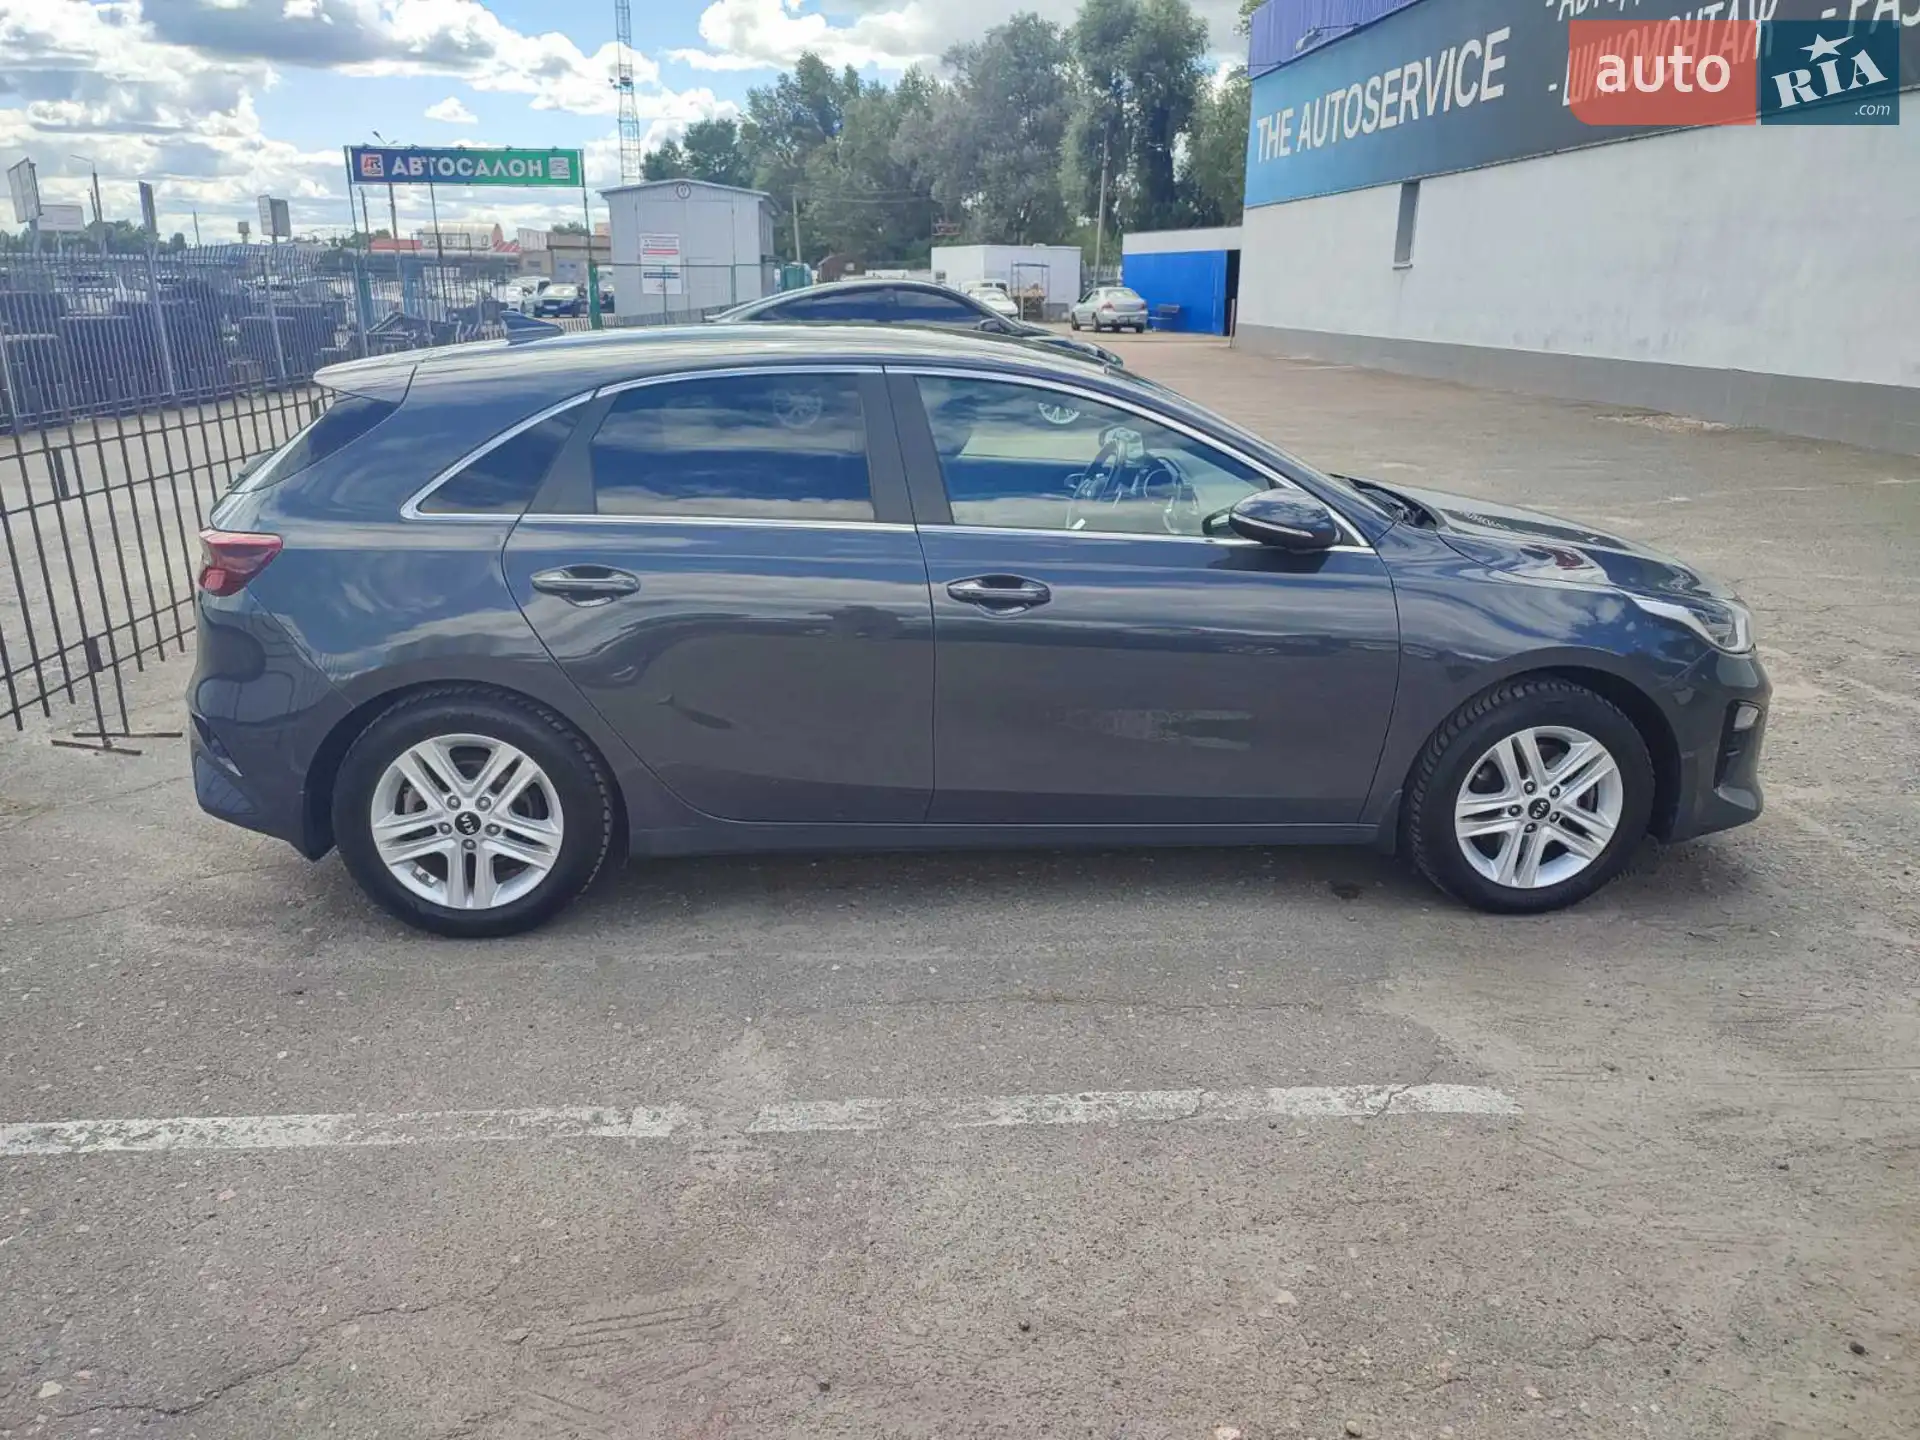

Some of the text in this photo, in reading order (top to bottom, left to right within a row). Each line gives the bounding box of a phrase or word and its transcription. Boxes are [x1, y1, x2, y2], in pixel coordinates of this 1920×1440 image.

[1256, 26, 1512, 163] THE AUTOSERVICE
[391, 156, 543, 178] АВТОСАЛОН
